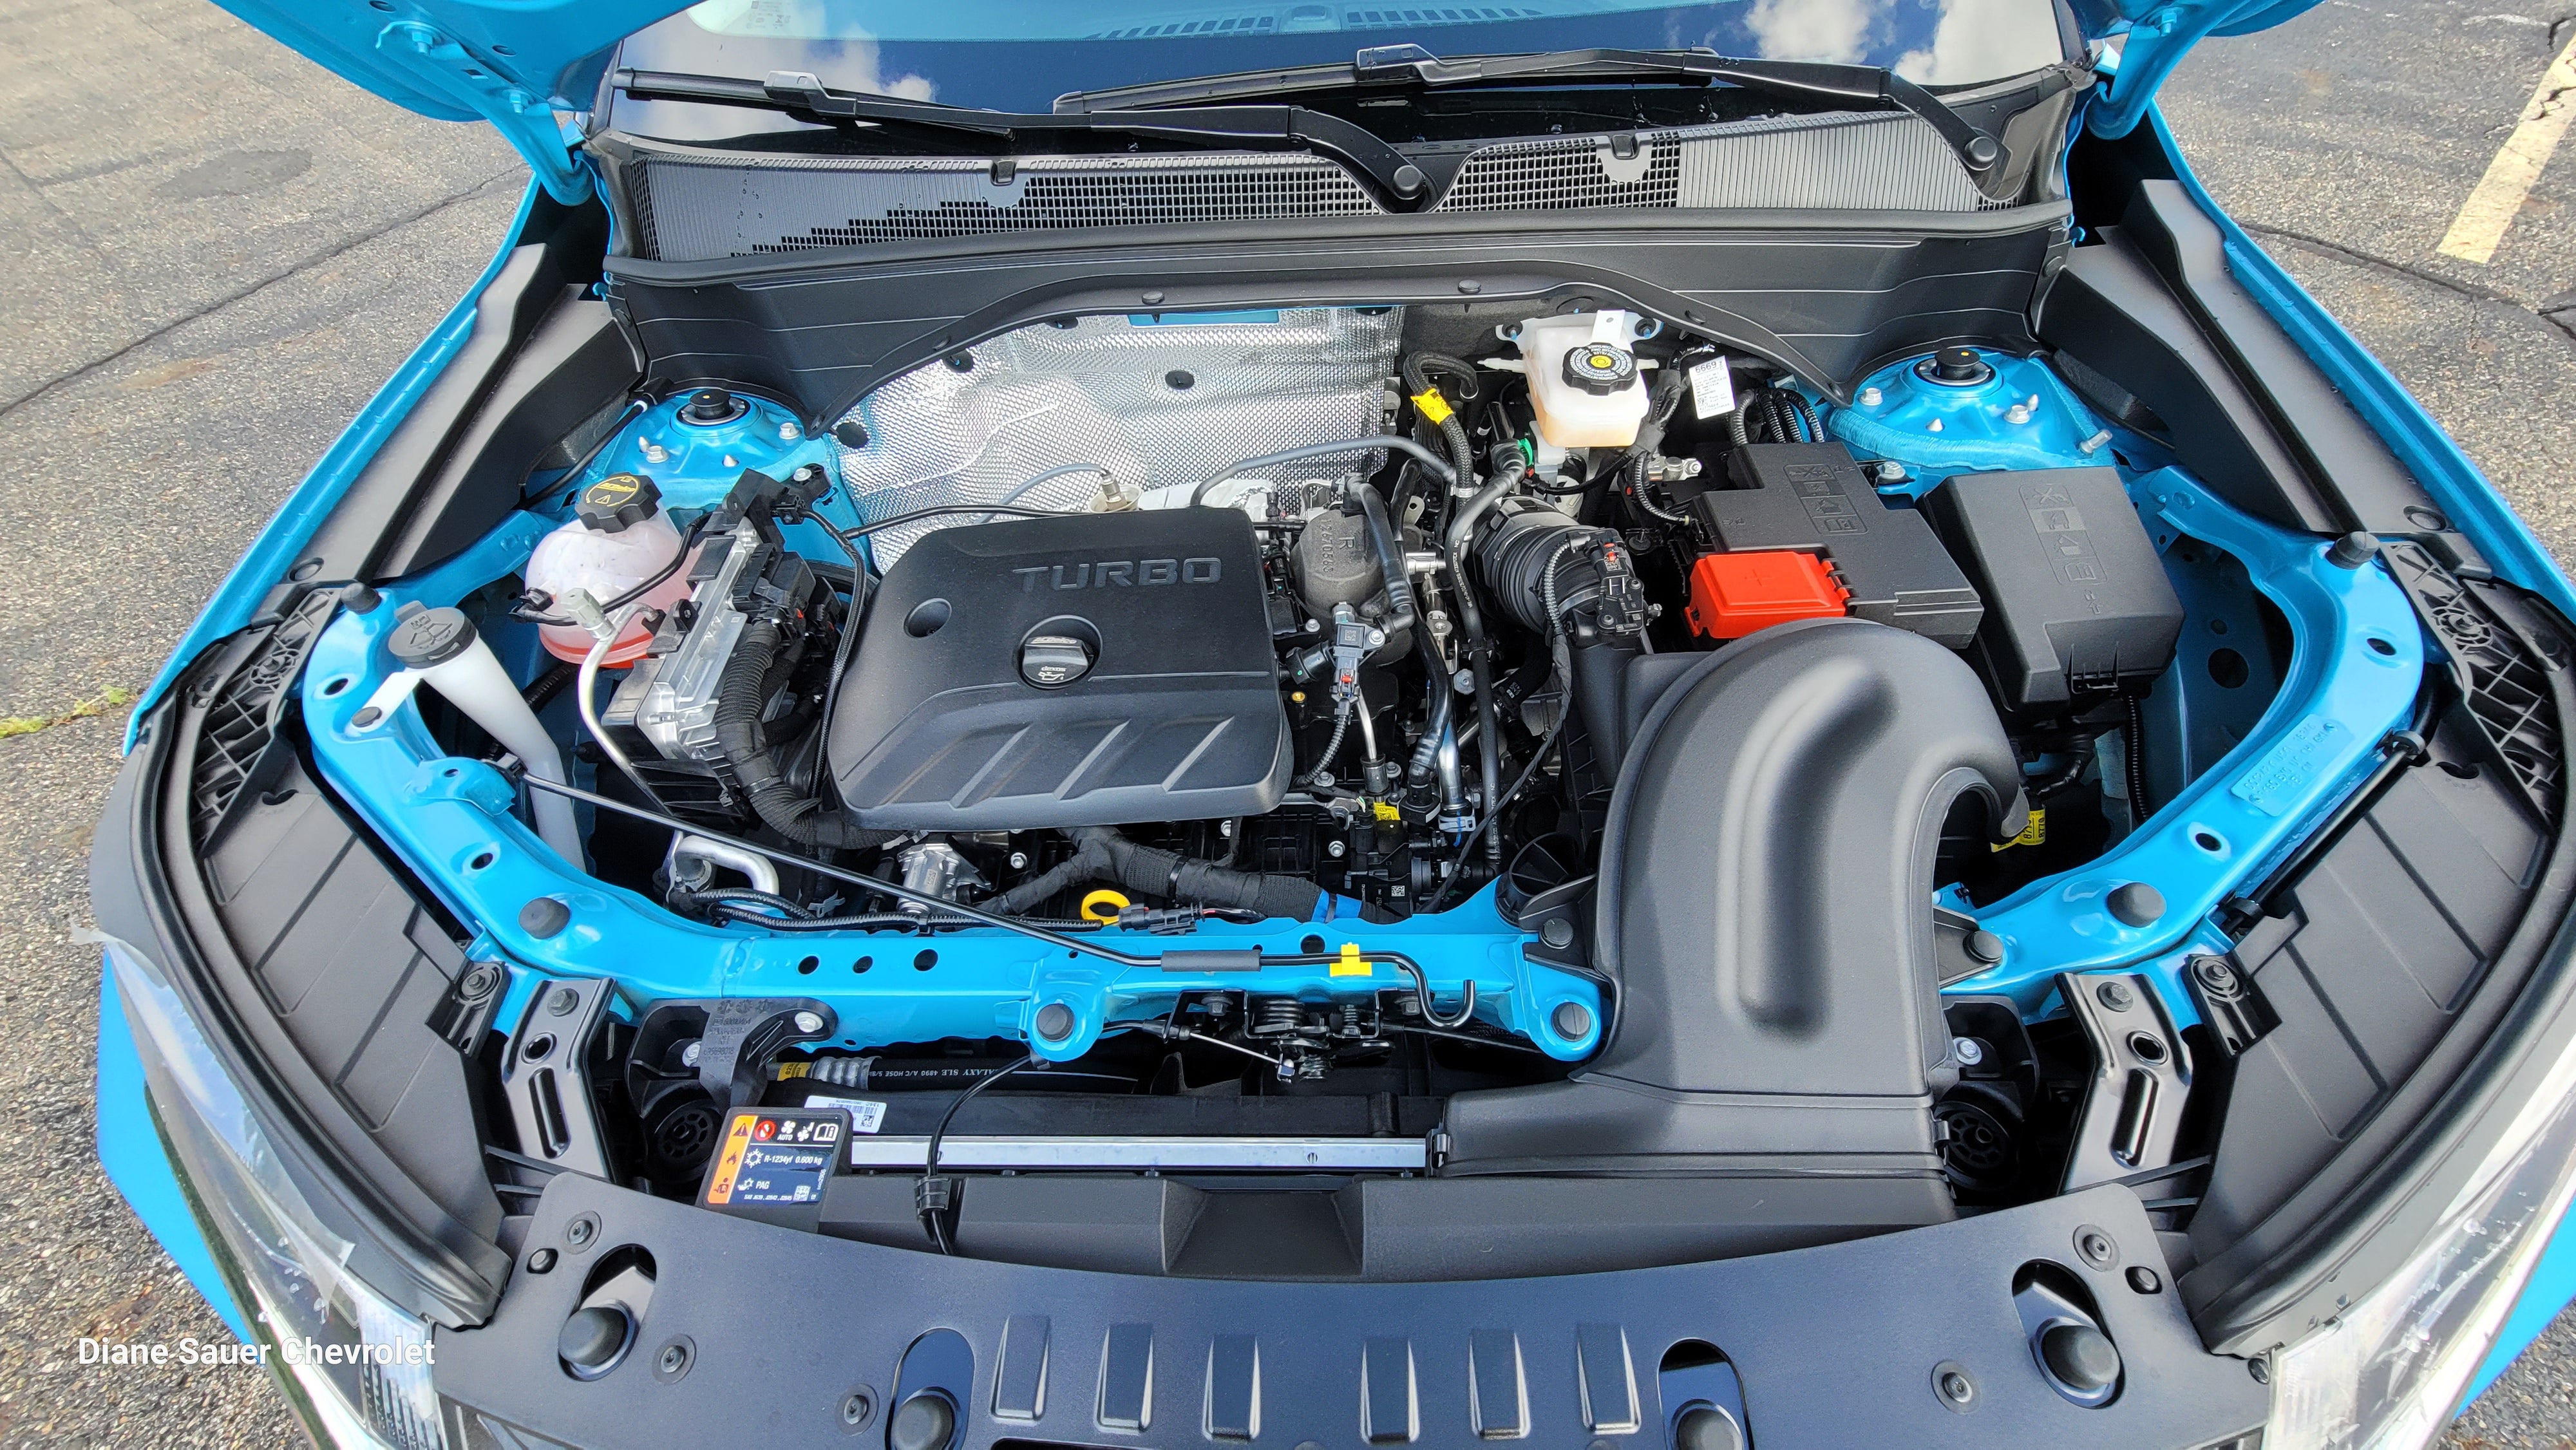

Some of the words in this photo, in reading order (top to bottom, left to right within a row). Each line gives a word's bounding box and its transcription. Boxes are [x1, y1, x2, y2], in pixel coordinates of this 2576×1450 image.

[1695, 361, 1716, 373] 6669
[1339, 536, 1355, 549] R
[1013, 558, 1222, 593] TURBO
[764, 1155, 793, 1164] R-1234yf
[813, 1157, 823, 1165] kg
[755, 1181, 770, 1189] PAG
